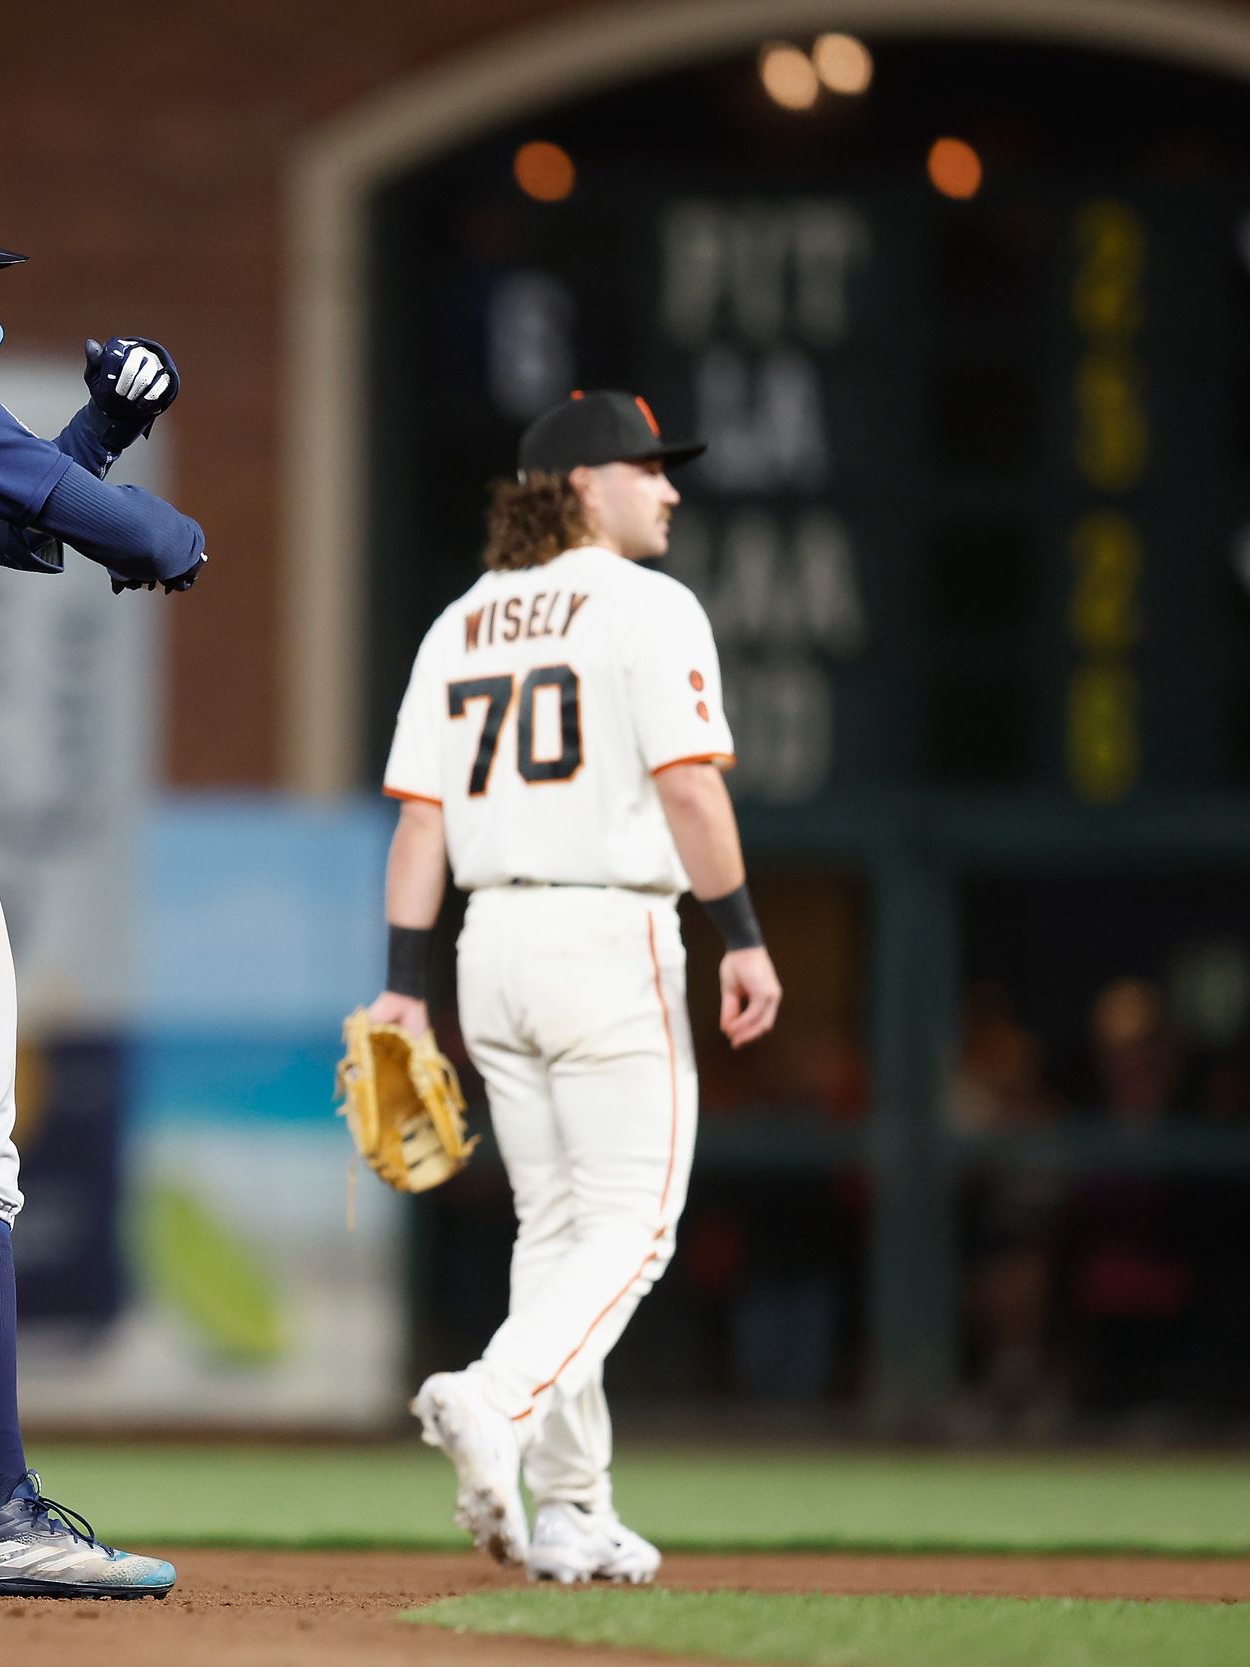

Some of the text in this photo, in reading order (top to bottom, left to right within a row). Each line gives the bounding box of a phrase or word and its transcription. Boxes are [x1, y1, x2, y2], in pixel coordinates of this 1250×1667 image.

[662, 208, 871, 344] PIT
[465, 591, 589, 653] WISELY
[446, 662, 584, 797] 70
